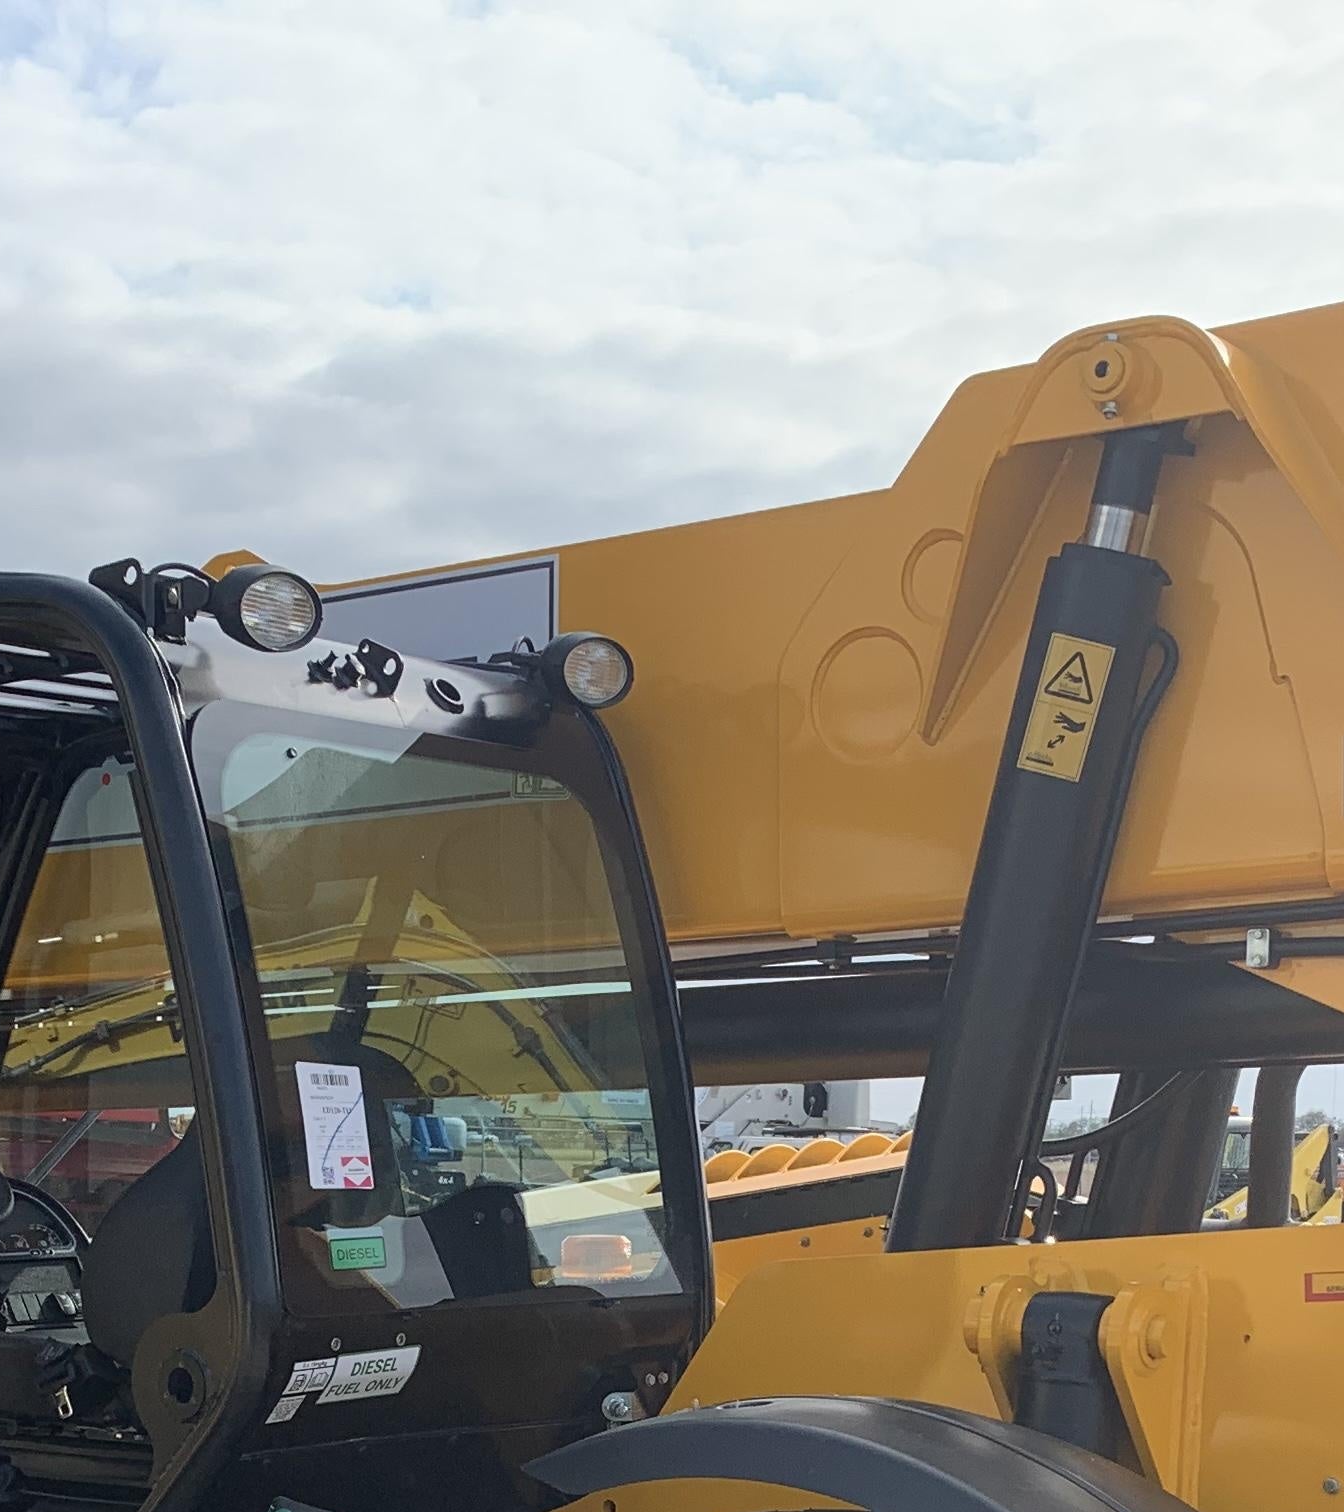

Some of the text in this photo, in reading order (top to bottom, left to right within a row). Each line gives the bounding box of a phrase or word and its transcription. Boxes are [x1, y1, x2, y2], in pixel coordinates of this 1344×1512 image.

[336, 1246, 380, 1262] DIESEL
[350, 1357, 399, 1377] DIESEL
[325, 1376, 405, 1398] FUEL ONLY
